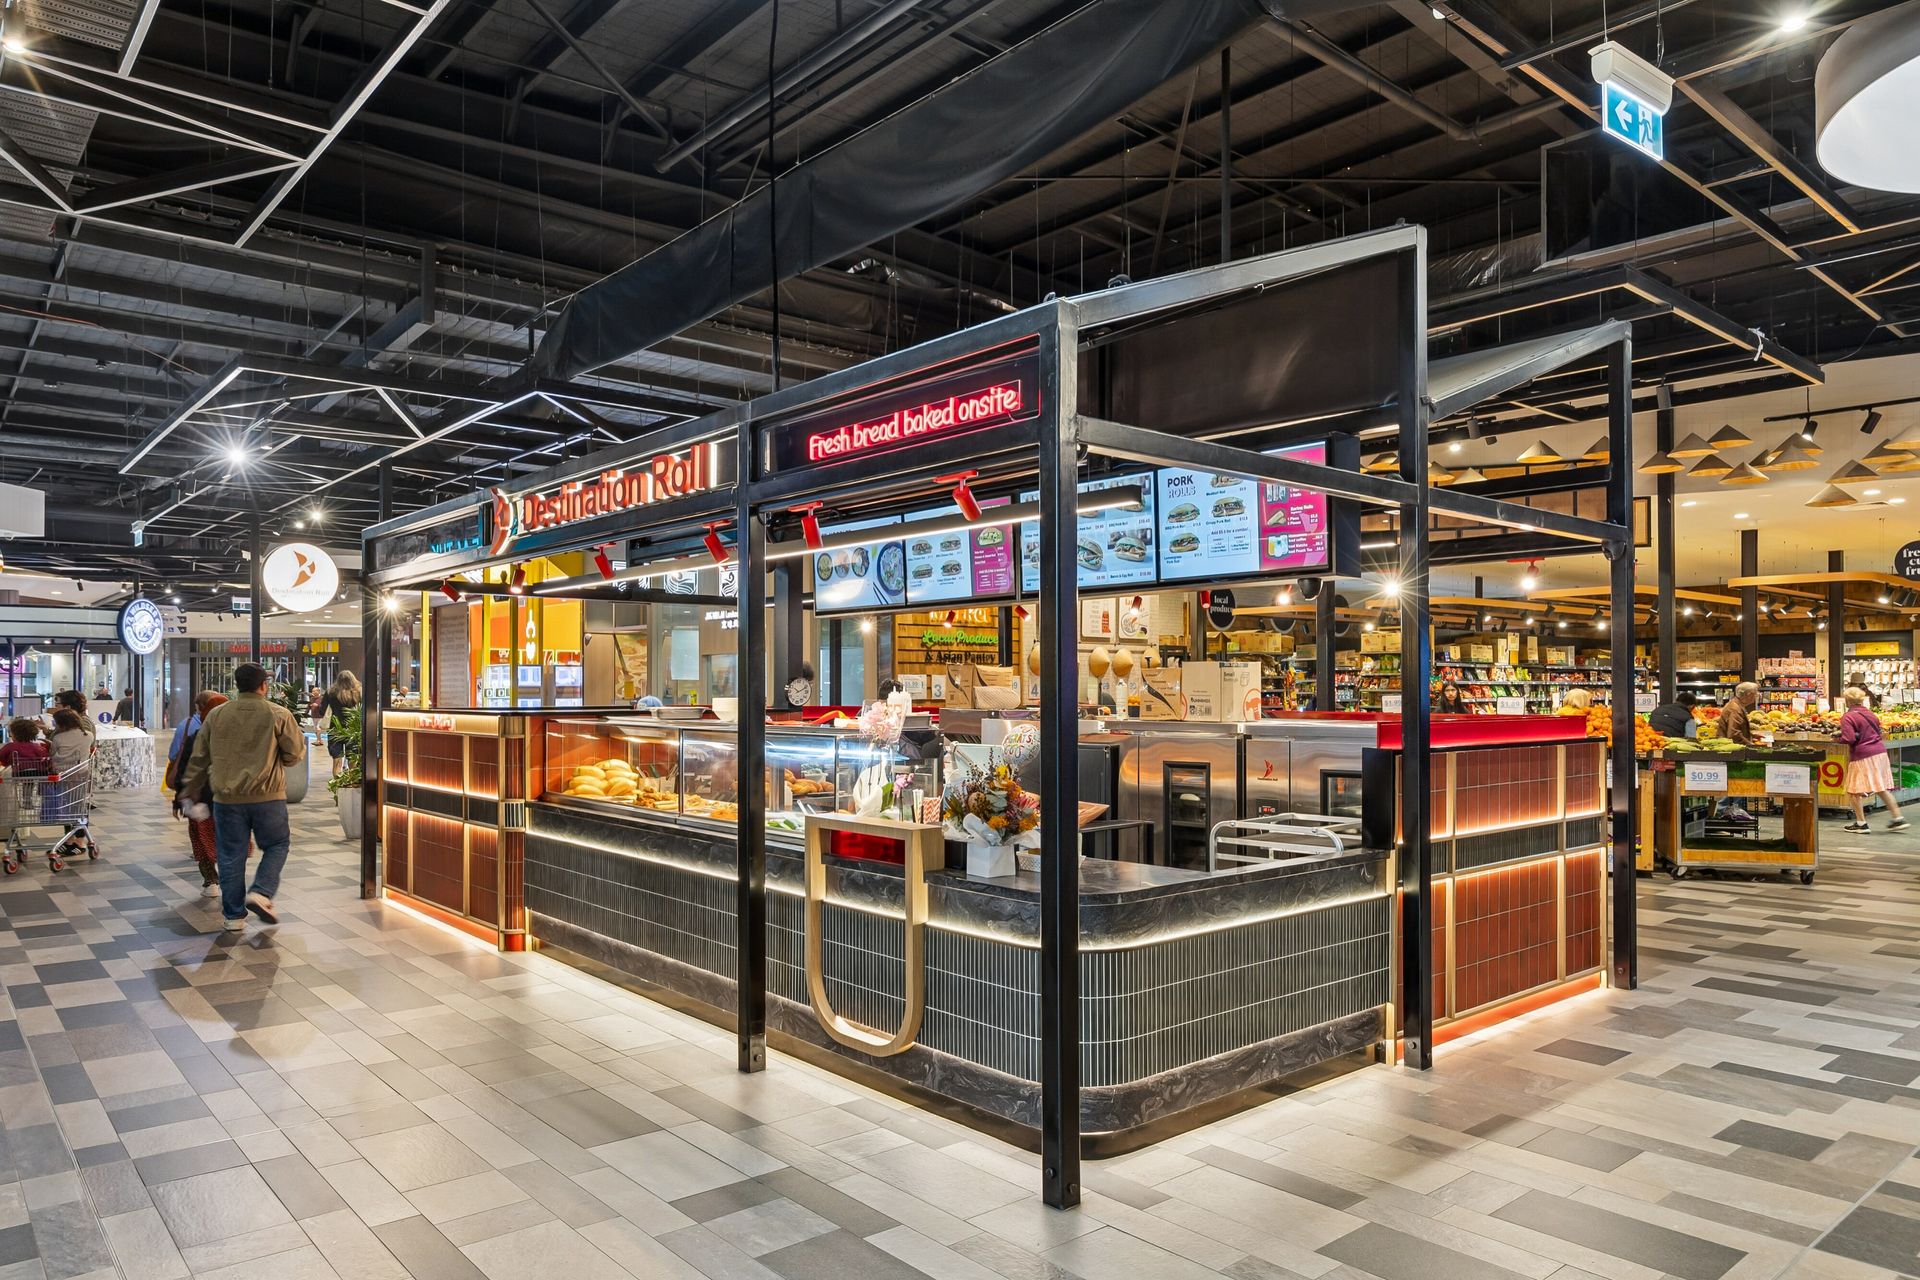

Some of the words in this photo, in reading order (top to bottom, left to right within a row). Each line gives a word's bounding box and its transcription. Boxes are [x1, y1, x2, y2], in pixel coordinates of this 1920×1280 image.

[809, 426, 851, 460] Fresh
[854, 412, 899, 448] bread
[903, 397, 955, 435] baked
[958, 387, 1019, 421] onsite
[522, 469, 648, 531] Destination
[652, 442, 709, 500] Roll
[1167, 475, 1194, 488] PORK
[1168, 487, 1197, 499] ROLLS
[1214, 595, 1229, 604] local
[1210, 604, 1232, 614] produc
[922, 630, 955, 647] Local
[957, 630, 999, 644] Produce
[925, 652, 933, 663] &
[936, 651, 963, 663] Asian
[965, 651, 996, 664] Pantry
[1691, 772, 1719, 780] $0.99
